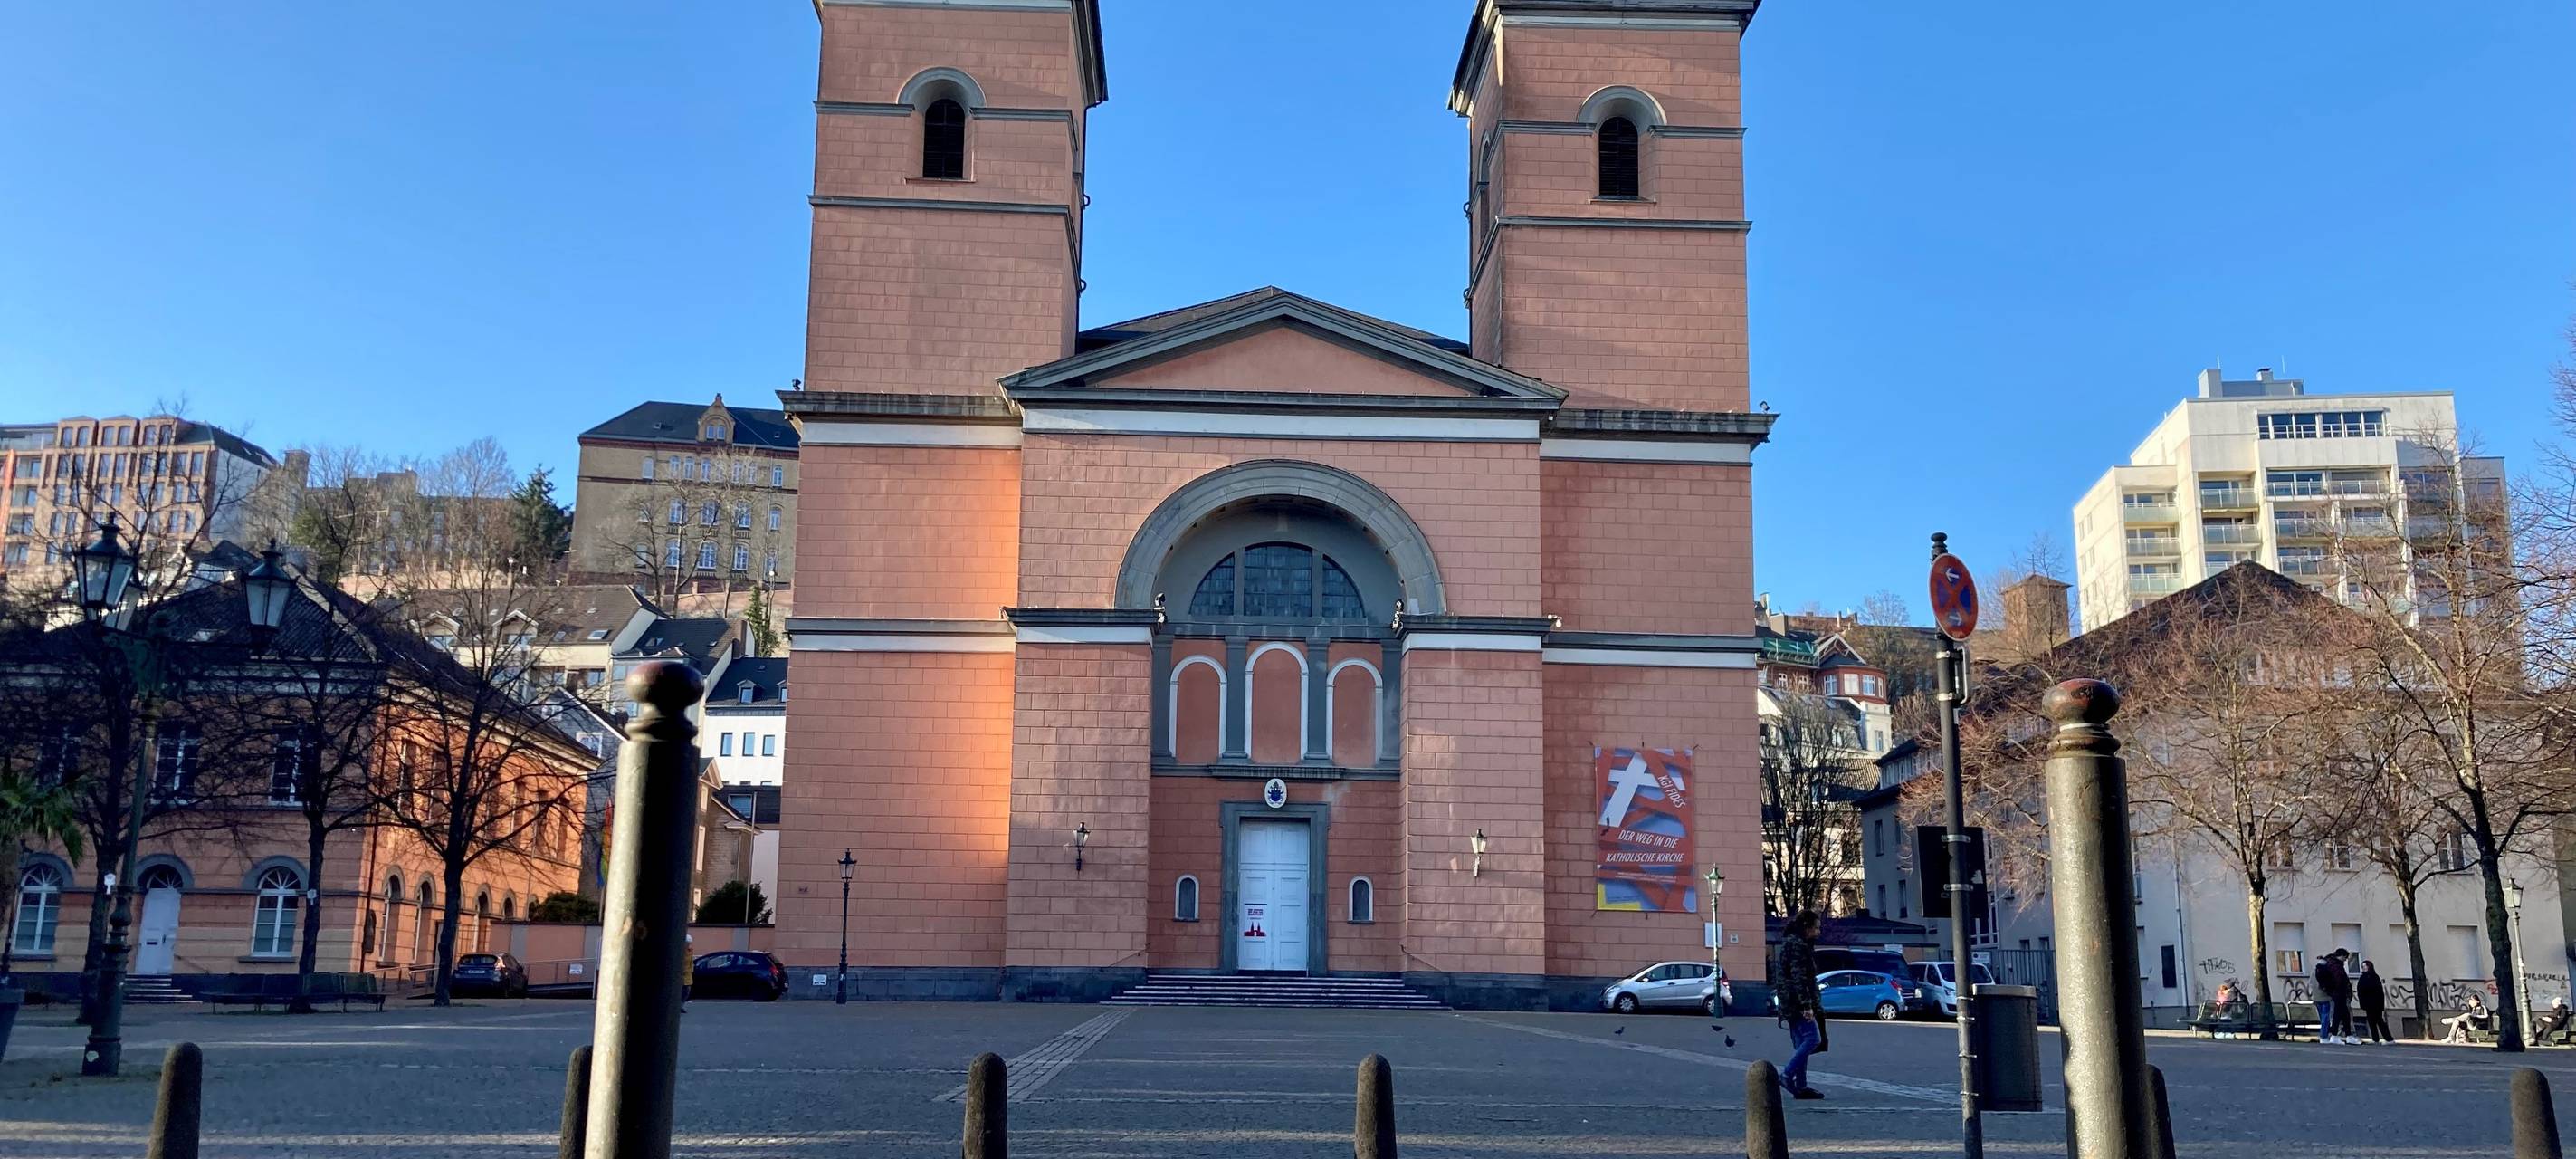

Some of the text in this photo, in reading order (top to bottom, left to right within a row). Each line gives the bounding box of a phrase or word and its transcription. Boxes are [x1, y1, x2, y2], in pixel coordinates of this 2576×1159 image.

[1658, 775, 1685, 808] KGI FIDES
[1618, 829, 1679, 849] DER WEG IN DIE
[1606, 852, 1684, 862] KATHOLISCHE KIRCHE
